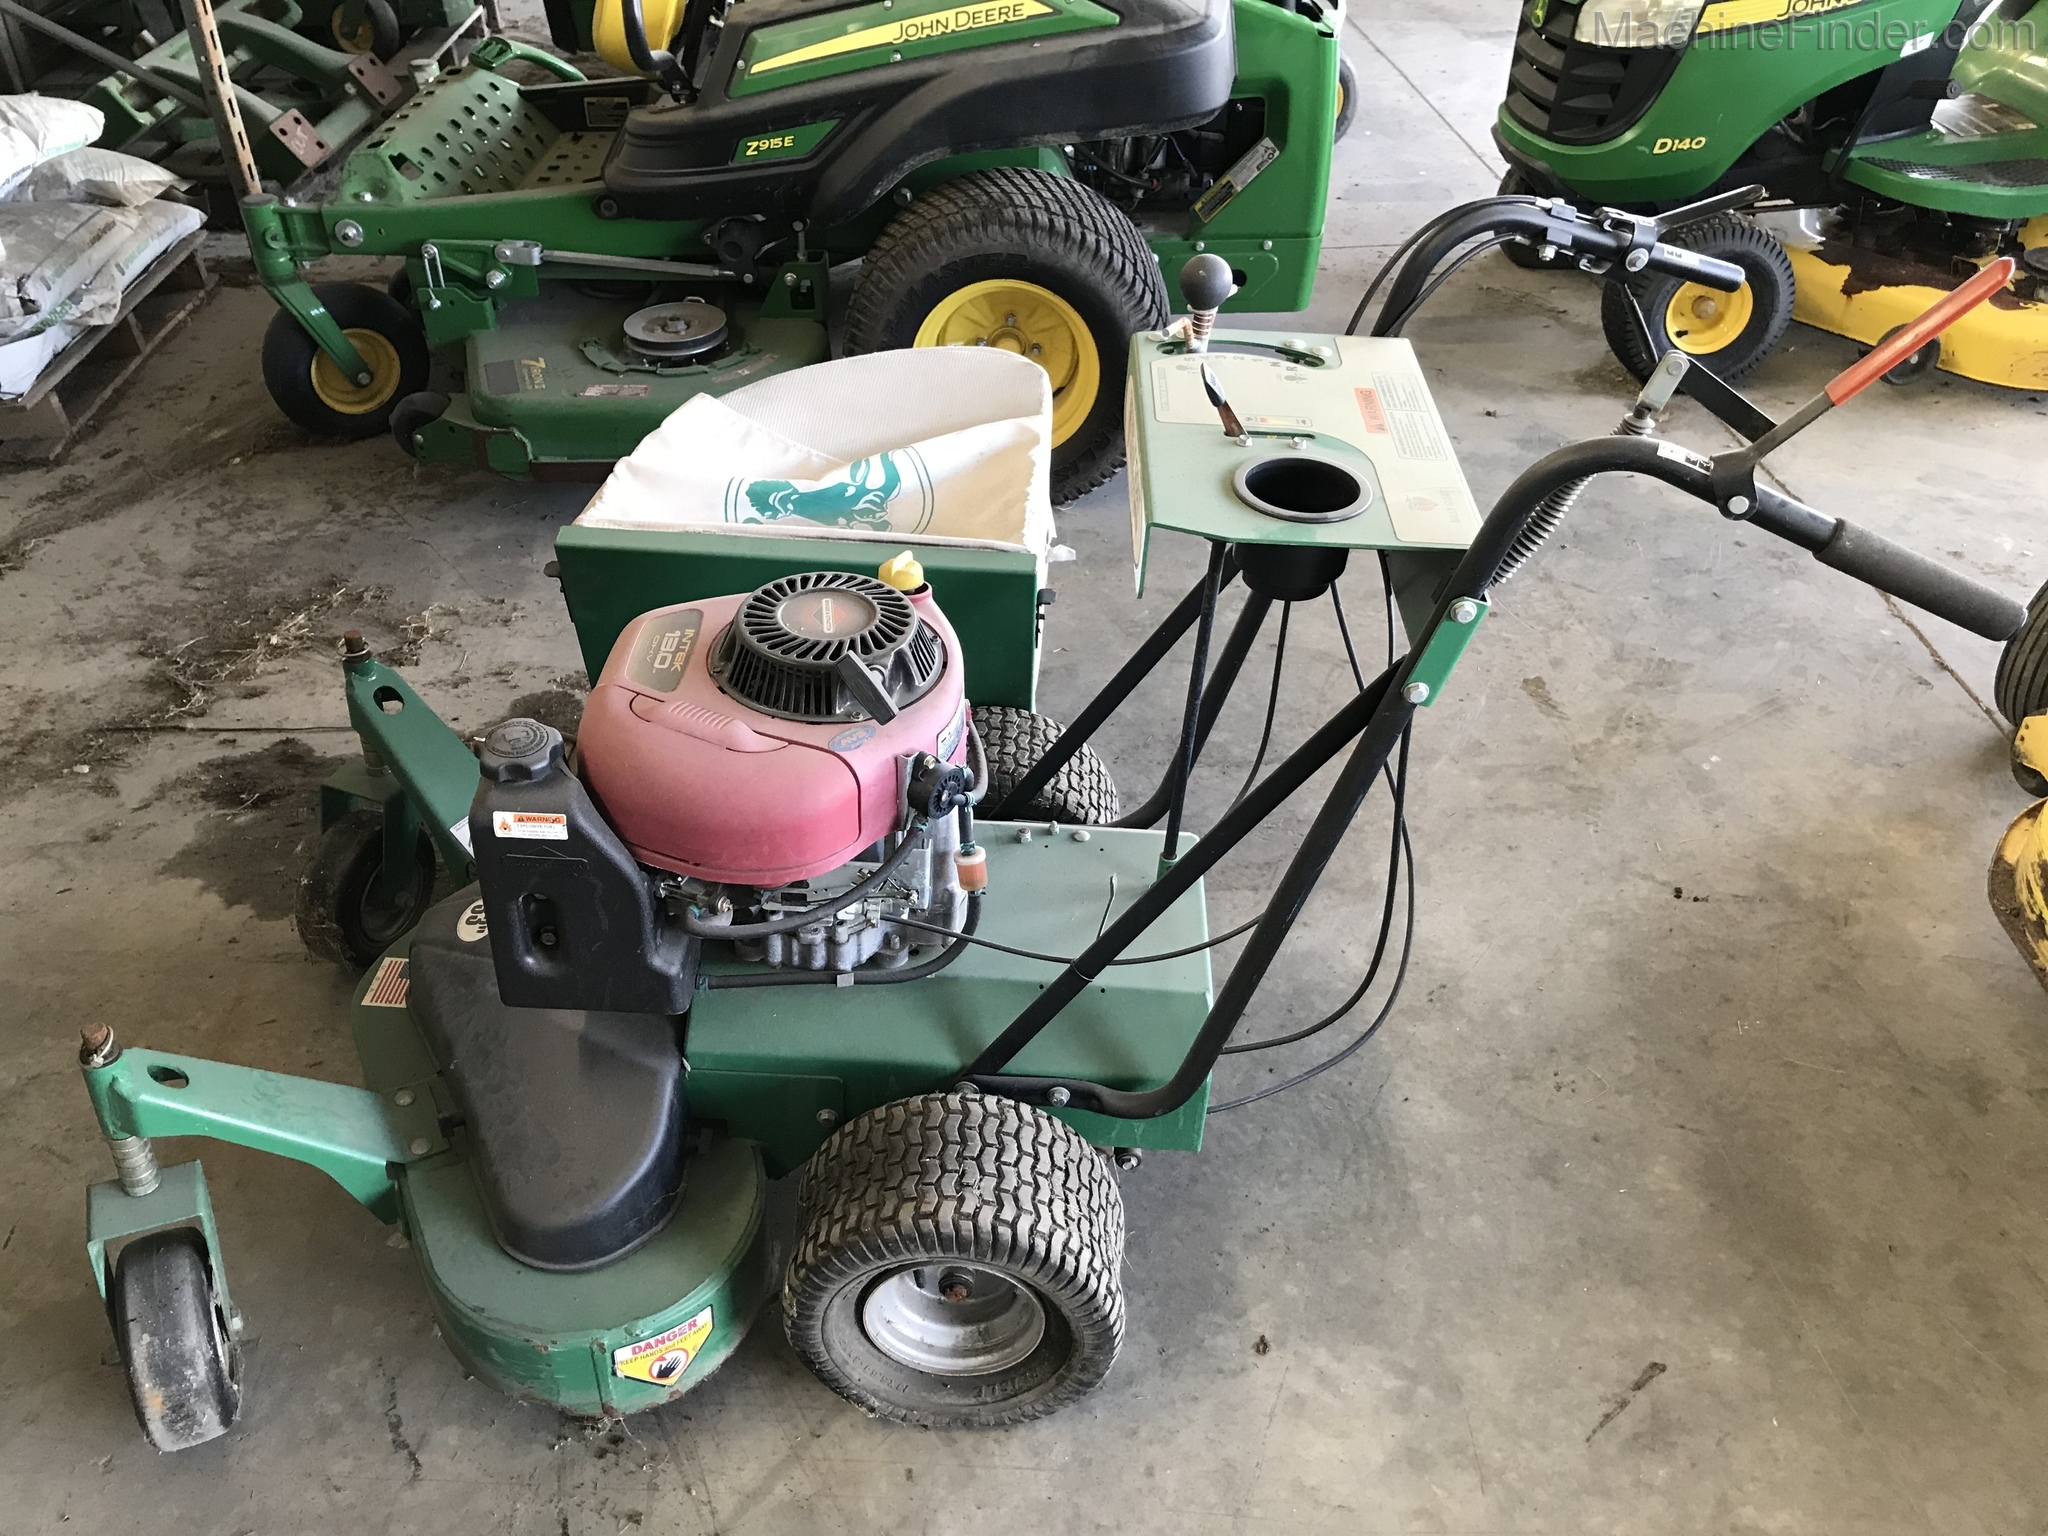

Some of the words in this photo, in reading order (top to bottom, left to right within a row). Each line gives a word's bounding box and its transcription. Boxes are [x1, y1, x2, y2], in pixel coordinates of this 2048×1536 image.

[892, 17, 950, 42] JOHN
[954, 3, 1025, 29] DEERE
[745, 135, 795, 156] Z915E
[1652, 136, 1707, 154] D140
[646, 634, 660, 663] OHV
[670, 628, 696, 673] INTEK
[620, 1357, 639, 1366] KEEP
[640, 1349, 663, 1361] HANDS
[664, 1342, 676, 1351] and
[677, 1332, 692, 1345] FEET
[692, 1322, 708, 1336] AWAY
[631, 1319, 698, 1356] DANGER
